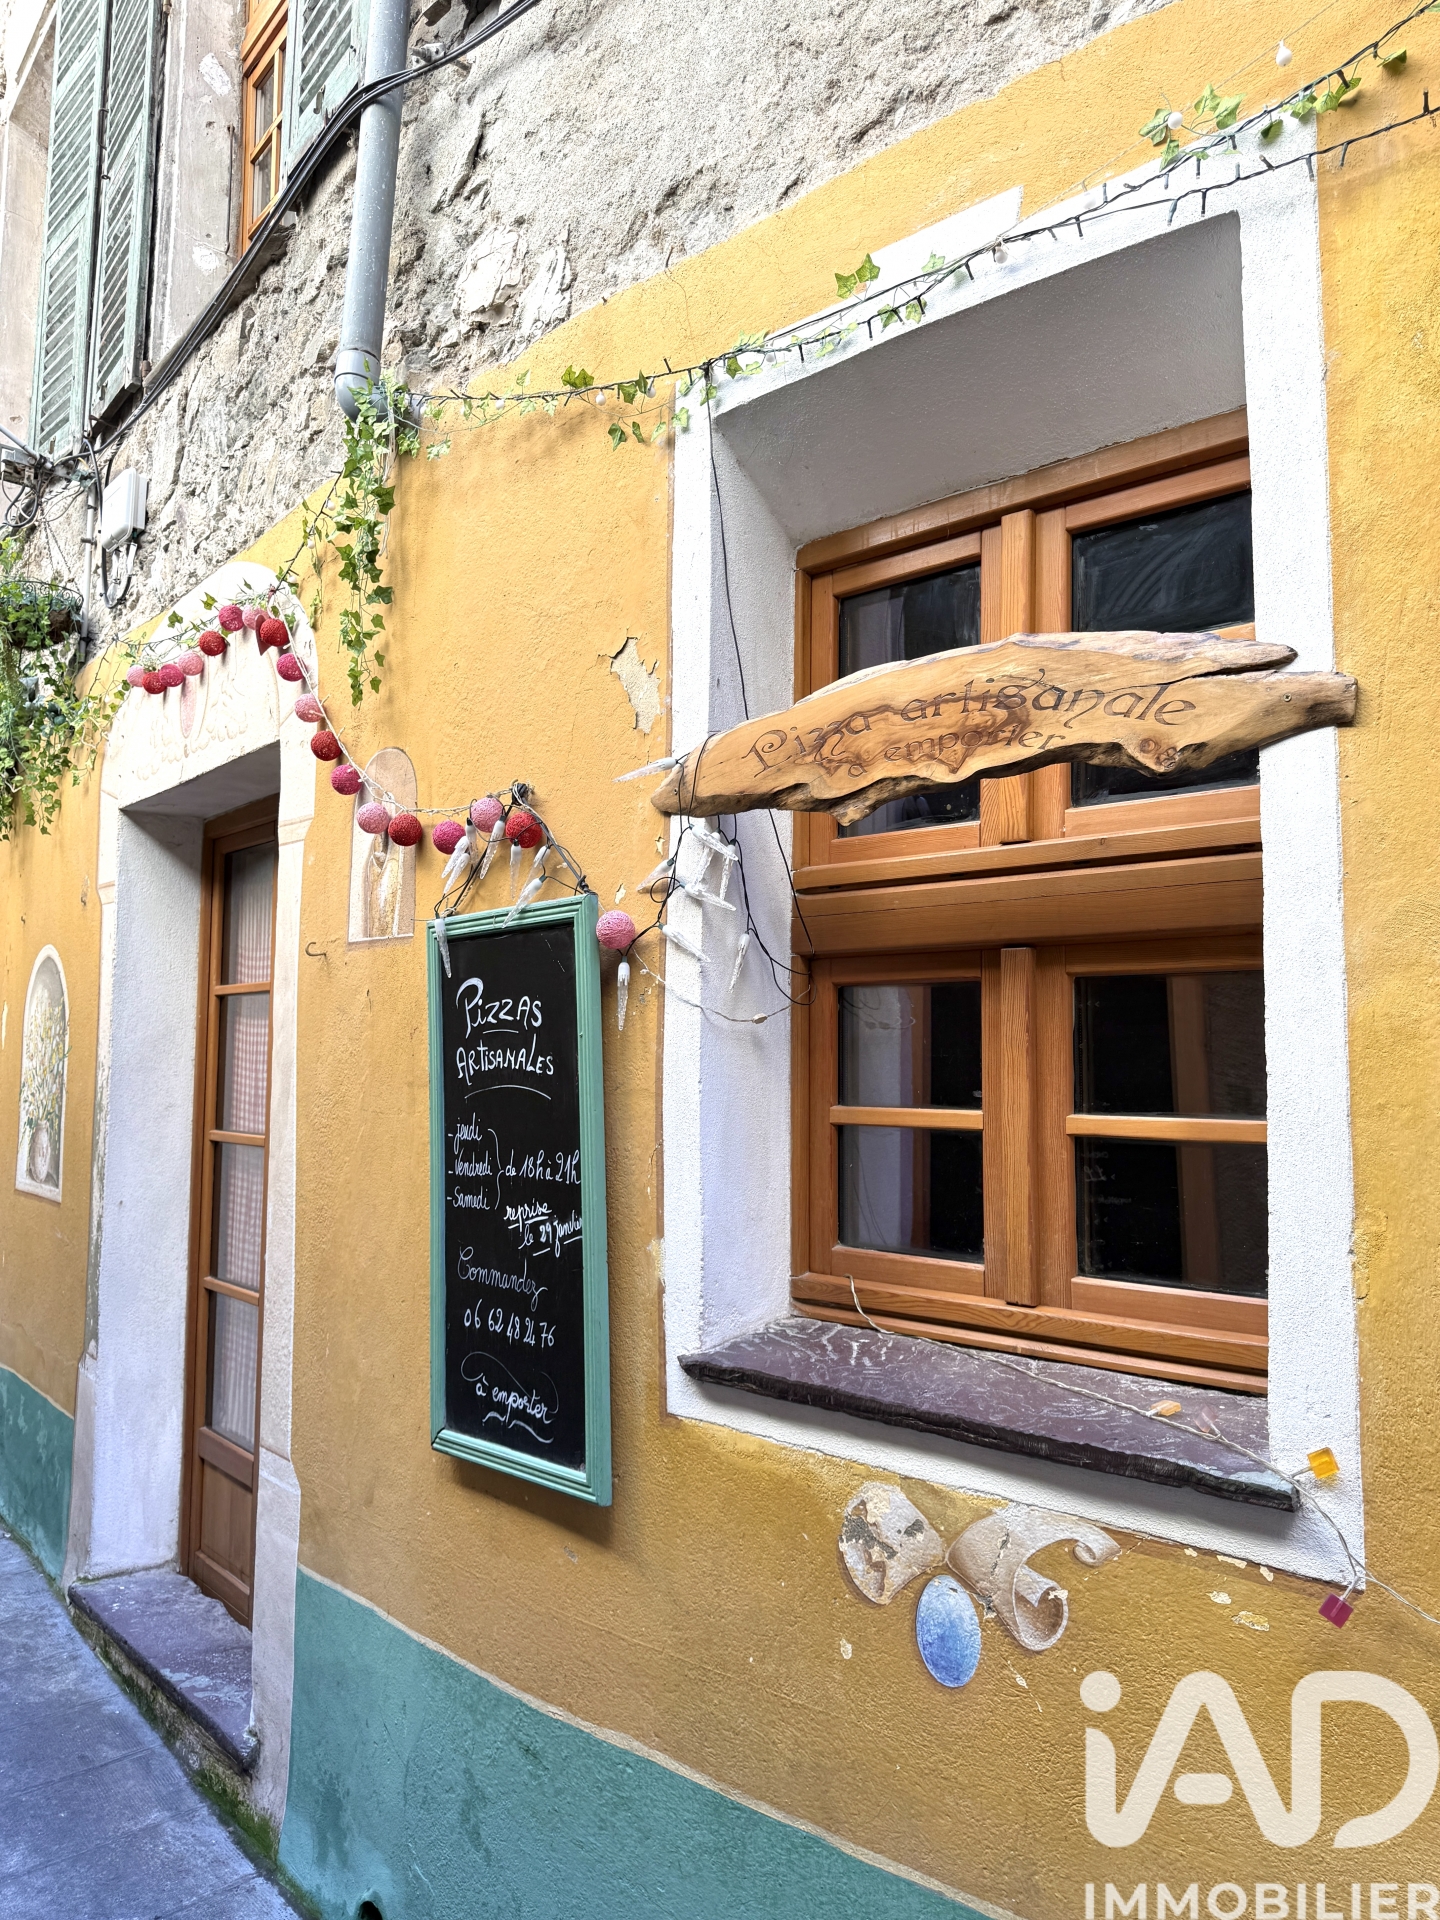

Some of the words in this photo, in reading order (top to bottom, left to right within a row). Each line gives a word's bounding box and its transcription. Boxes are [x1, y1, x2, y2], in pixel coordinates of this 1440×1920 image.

[741, 712, 873, 779] Pizza
[900, 668, 1197, 729] artisanale
[884, 723, 1066, 762] emporter
[505, 1149, 517, 1176] de
[519, 1150, 544, 1180] 18h
[555, 1149, 581, 1184] 21h
[503, 1198, 552, 1233] reprise
[518, 1223, 534, 1250] le
[539, 1222, 552, 1244] 29
[457, 1247, 549, 1312] Commandez
[464, 1299, 482, 1329] 06
[488, 1308, 504, 1333] 62
[506, 1313, 520, 1346] 48
[539, 1322, 556, 1348] 76
[476, 1375, 489, 1396] à
[492, 1389, 551, 1424] emporter
